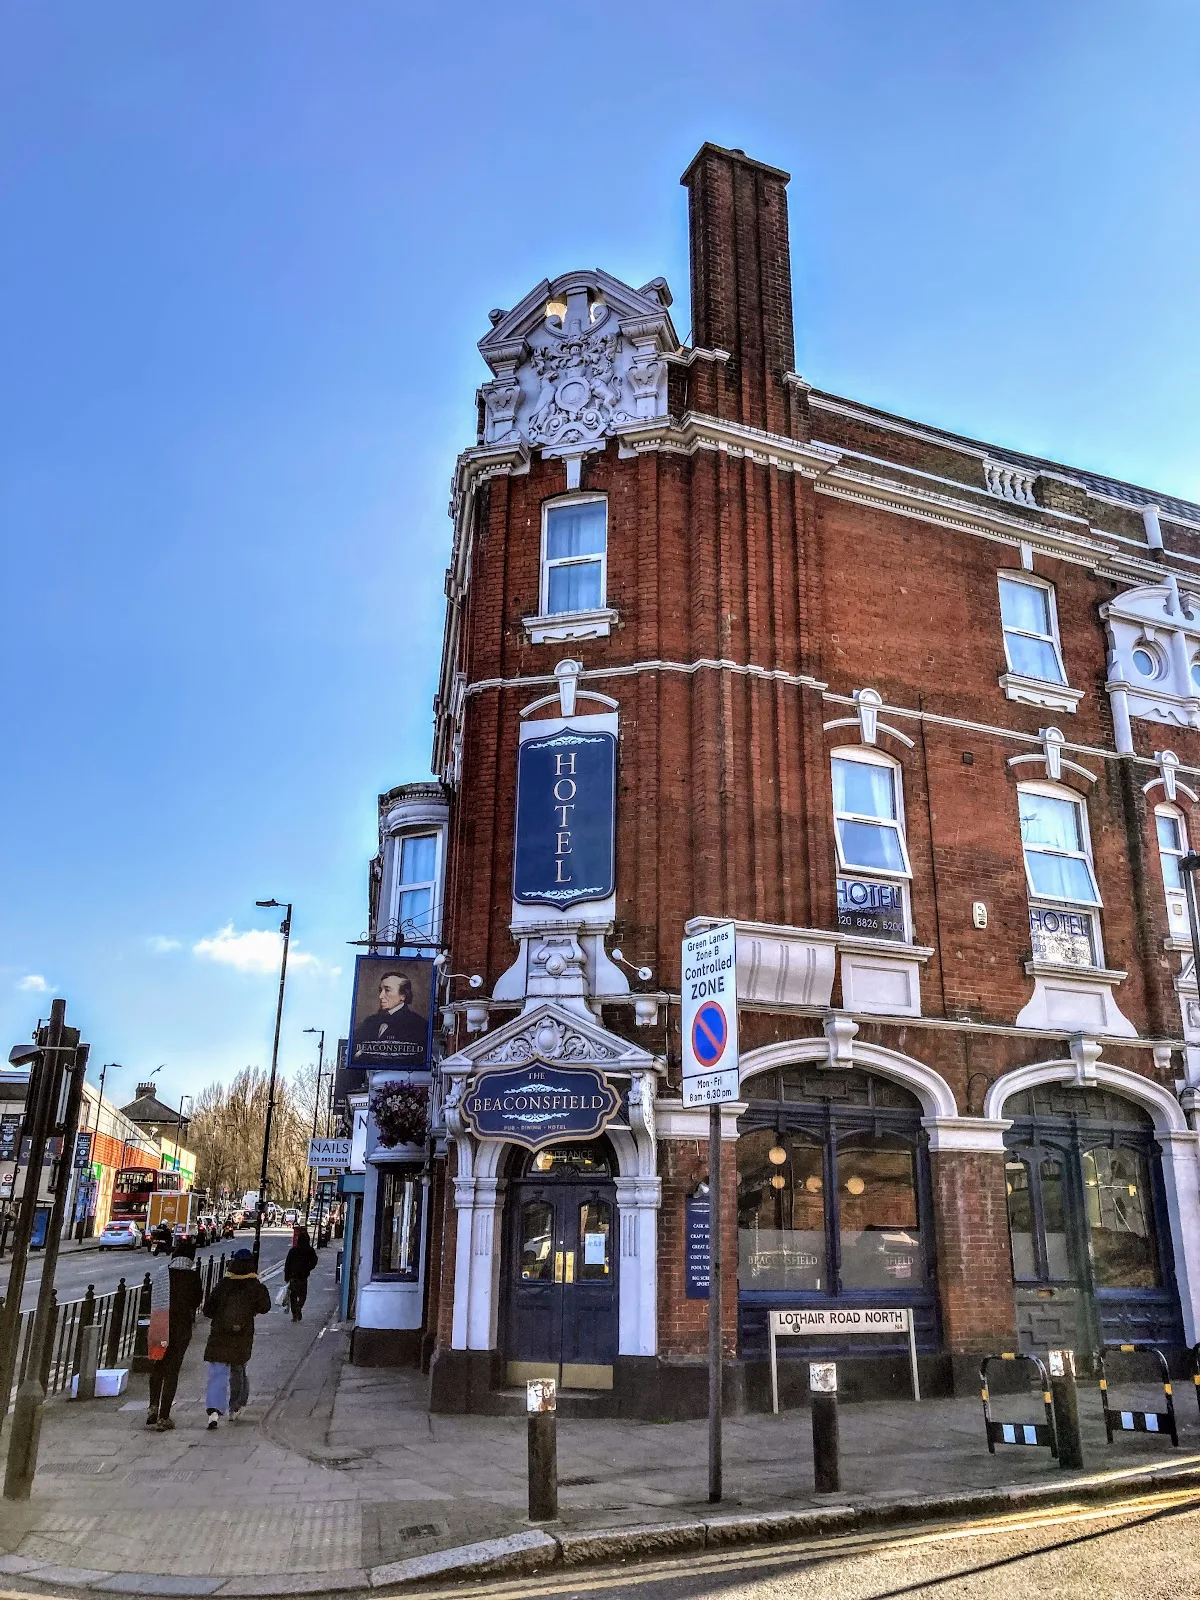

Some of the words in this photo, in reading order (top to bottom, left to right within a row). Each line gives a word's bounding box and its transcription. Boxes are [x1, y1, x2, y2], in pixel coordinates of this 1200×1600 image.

[553, 752, 578, 883] HOTEL
[837, 881, 902, 909] HOTEL
[856, 917, 878, 929] 8826
[1029, 909, 1088, 937] HOTEL
[687, 939, 707, 952] Green
[709, 931, 729, 945] Lanes
[696, 949, 712, 962] Zone
[714, 945, 720, 956] B
[684, 954, 732, 981] Controlled
[691, 976, 725, 1000] ZONE
[356, 1043, 424, 1053] BEACONSFIELD
[528, 1072, 546, 1080] THE
[473, 1095, 604, 1112] BEACONSFIELD
[310, 1142, 349, 1154] NAILS
[779, 1313, 825, 1325] LOTHAIR
[830, 1312, 861, 1324] ROAD
[865, 1311, 903, 1323] NORTH
